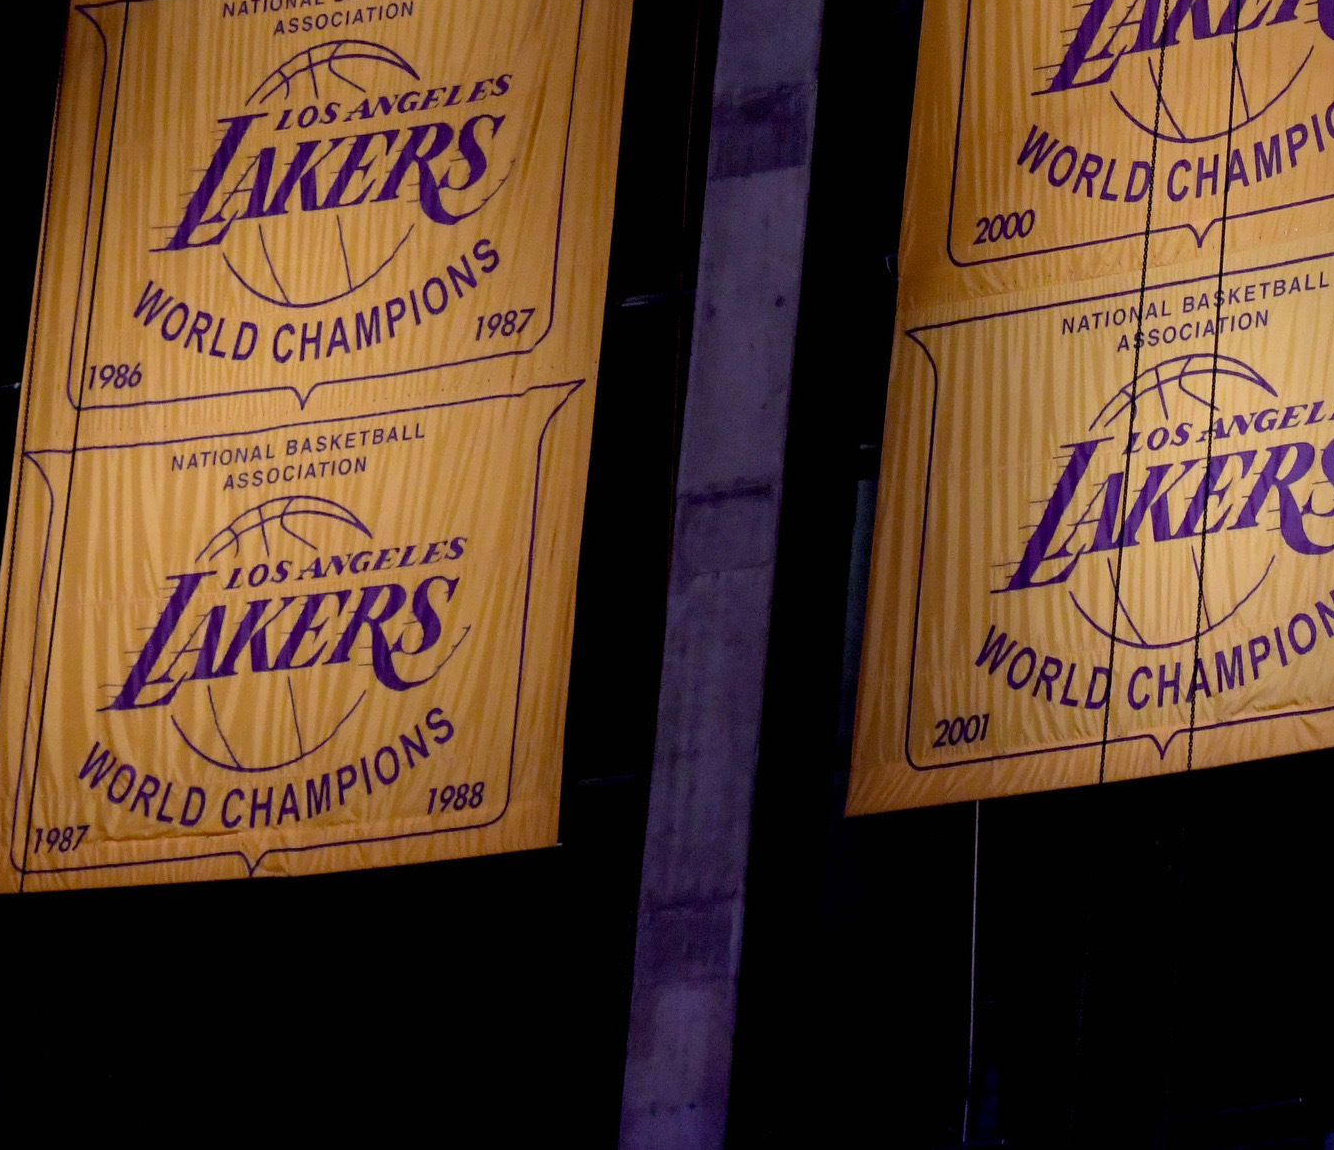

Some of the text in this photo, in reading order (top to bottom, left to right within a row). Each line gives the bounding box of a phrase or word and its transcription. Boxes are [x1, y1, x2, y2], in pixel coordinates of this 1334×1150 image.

[274, 0, 414, 36] ASSOCIATION
[276, 74, 512, 131] LOS ANGELES
[149, 113, 505, 252] LAKERS
[1017, 125, 1151, 203] WORLD
[973, 210, 1035, 245] 2000
[134, 238, 500, 363] WORLD CHAMPIONS
[1062, 272, 1330, 335] NATIONAL BASKETBALL
[475, 309, 535, 341] 1987
[1117, 310, 1269, 352] ASSOCIATION
[88, 363, 142, 389] 1986
[171, 423, 425, 471] NATIONAL BASKETBALL
[1122, 425, 1191, 455] LOS
[223, 457, 367, 491] ASSOCIATION
[224, 536, 467, 590] LOS ANGELES
[96, 572, 459, 711] LAKERS
[976, 625, 1110, 709] WORLD
[933, 714, 990, 748] 2001
[78, 708, 455, 828] WORLD CHAMPIONS
[427, 782, 484, 814] 1988
[34, 826, 89, 853] 1987
